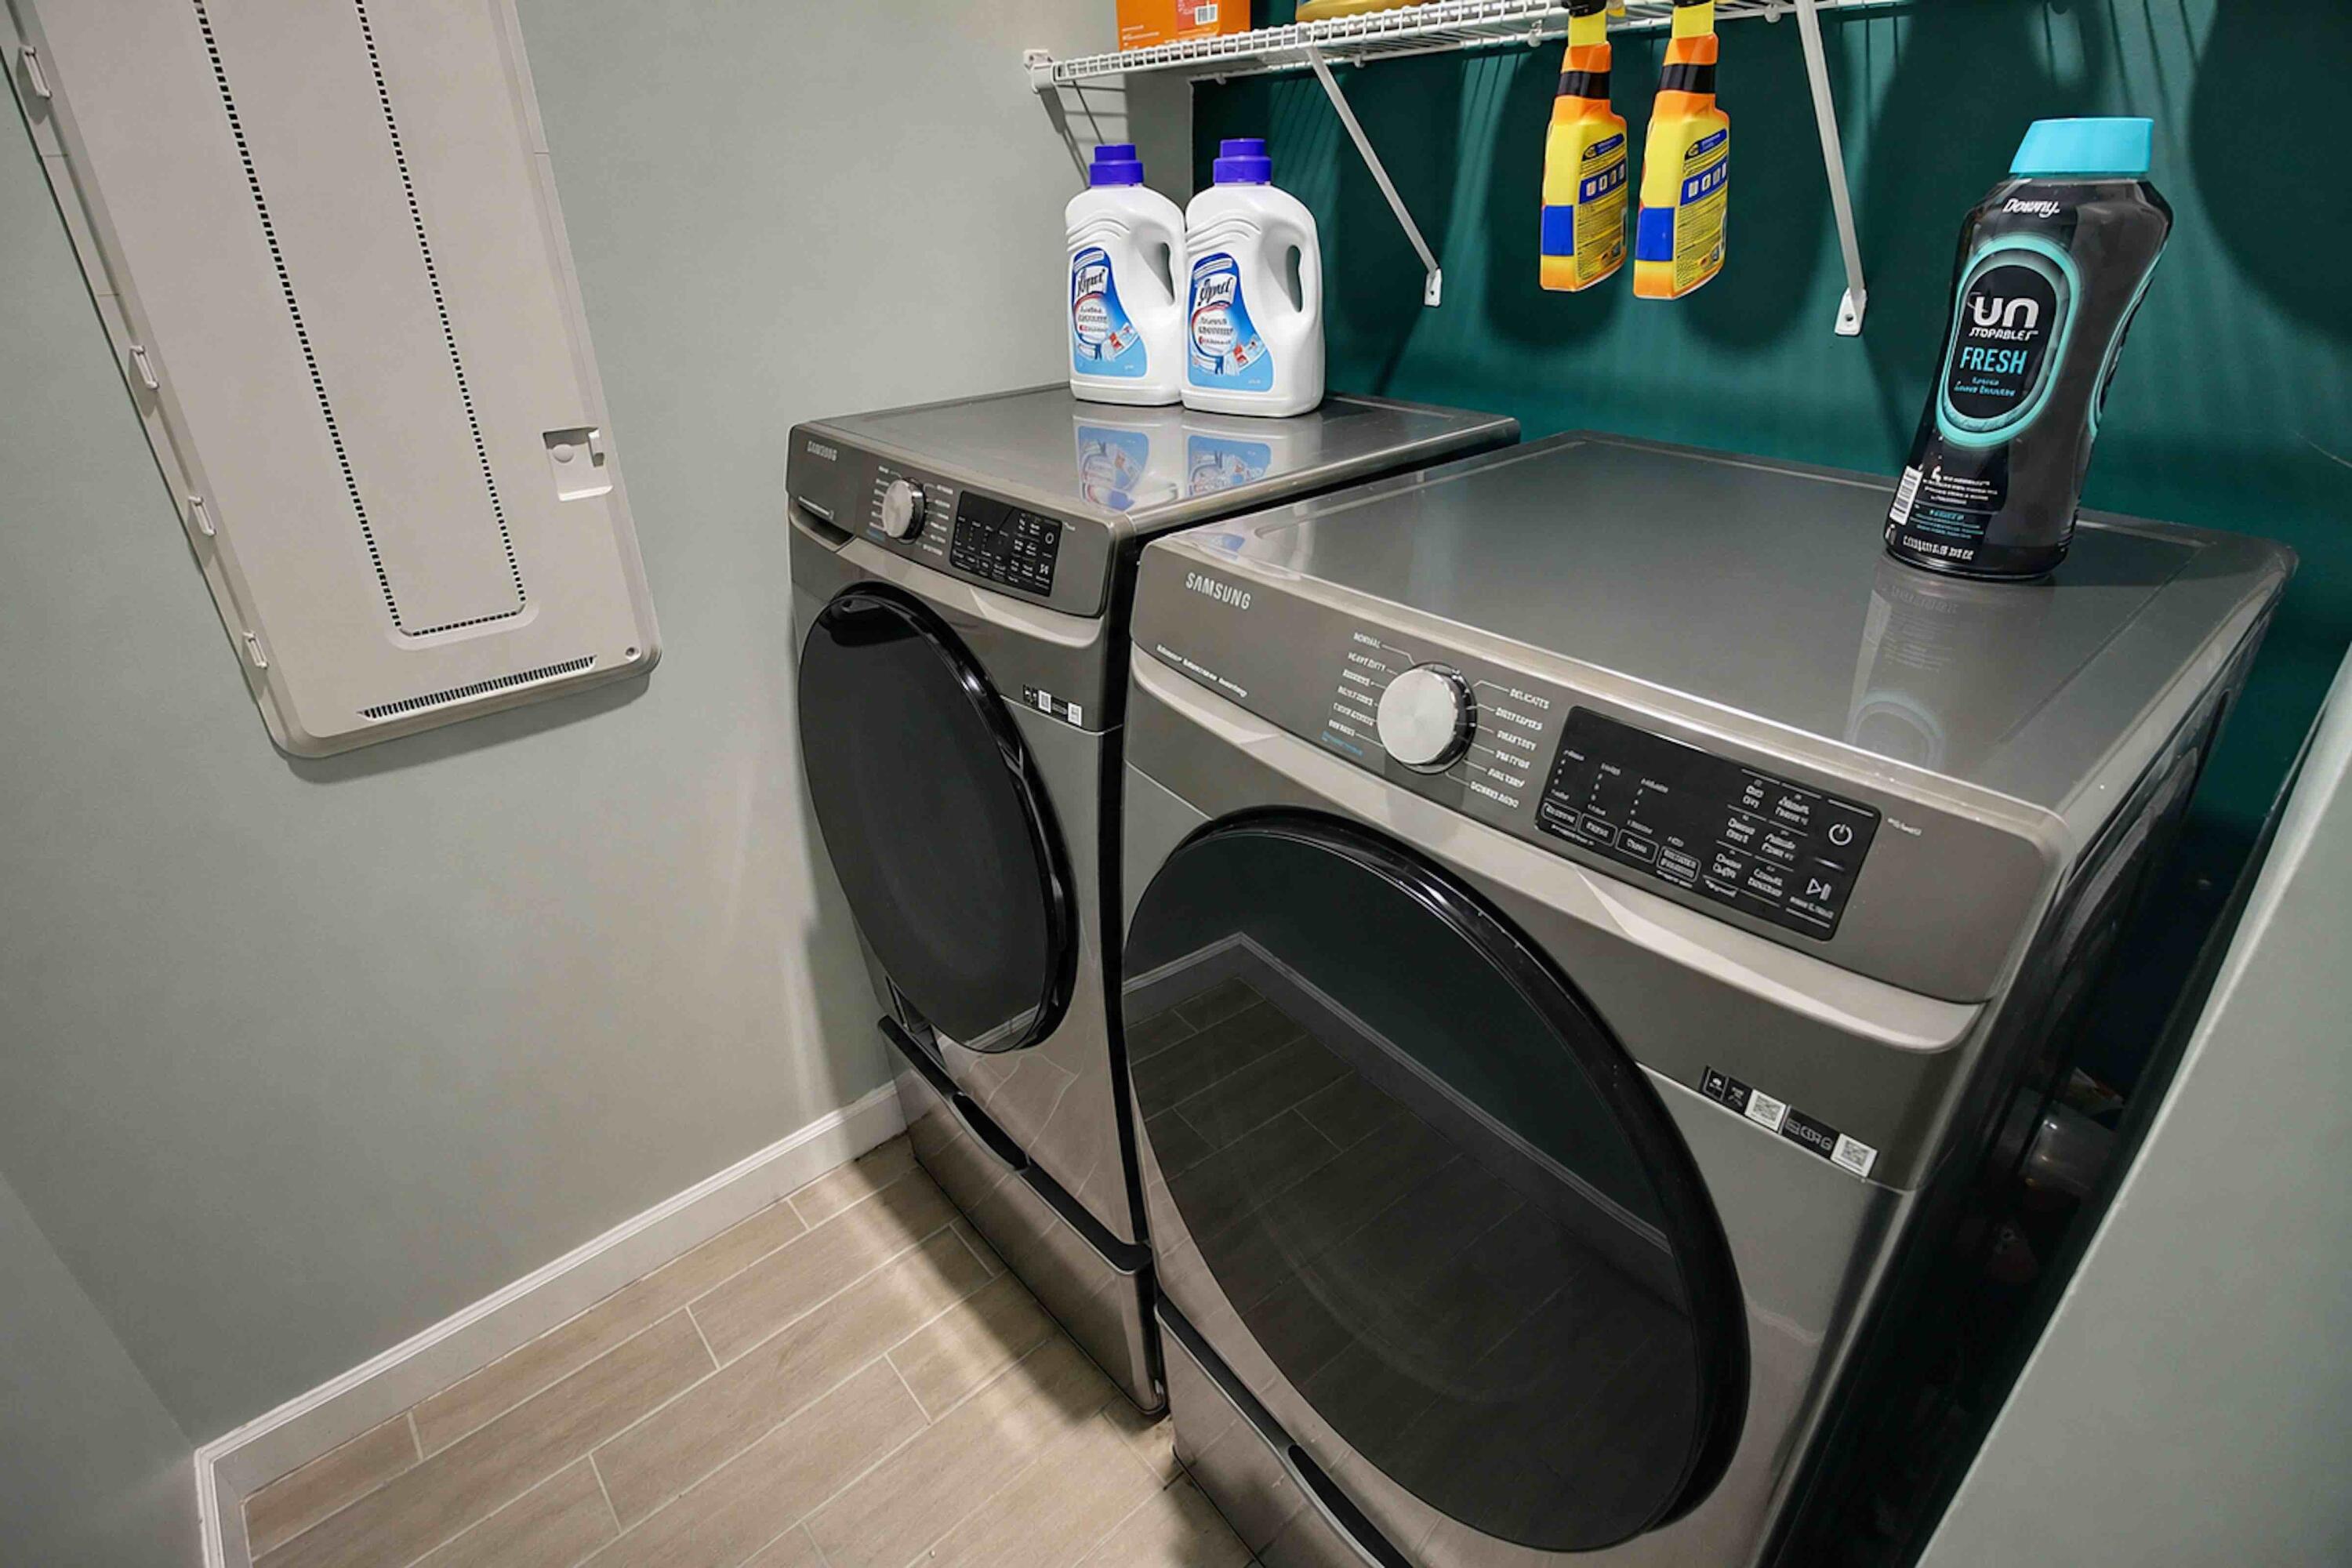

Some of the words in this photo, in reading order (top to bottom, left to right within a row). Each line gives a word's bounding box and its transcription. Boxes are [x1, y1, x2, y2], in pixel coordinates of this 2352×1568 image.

[2002, 198, 2059, 218] Downy
[1959, 346, 2028, 375] FRESH
[1185, 572, 1251, 610] SAMSUNG
